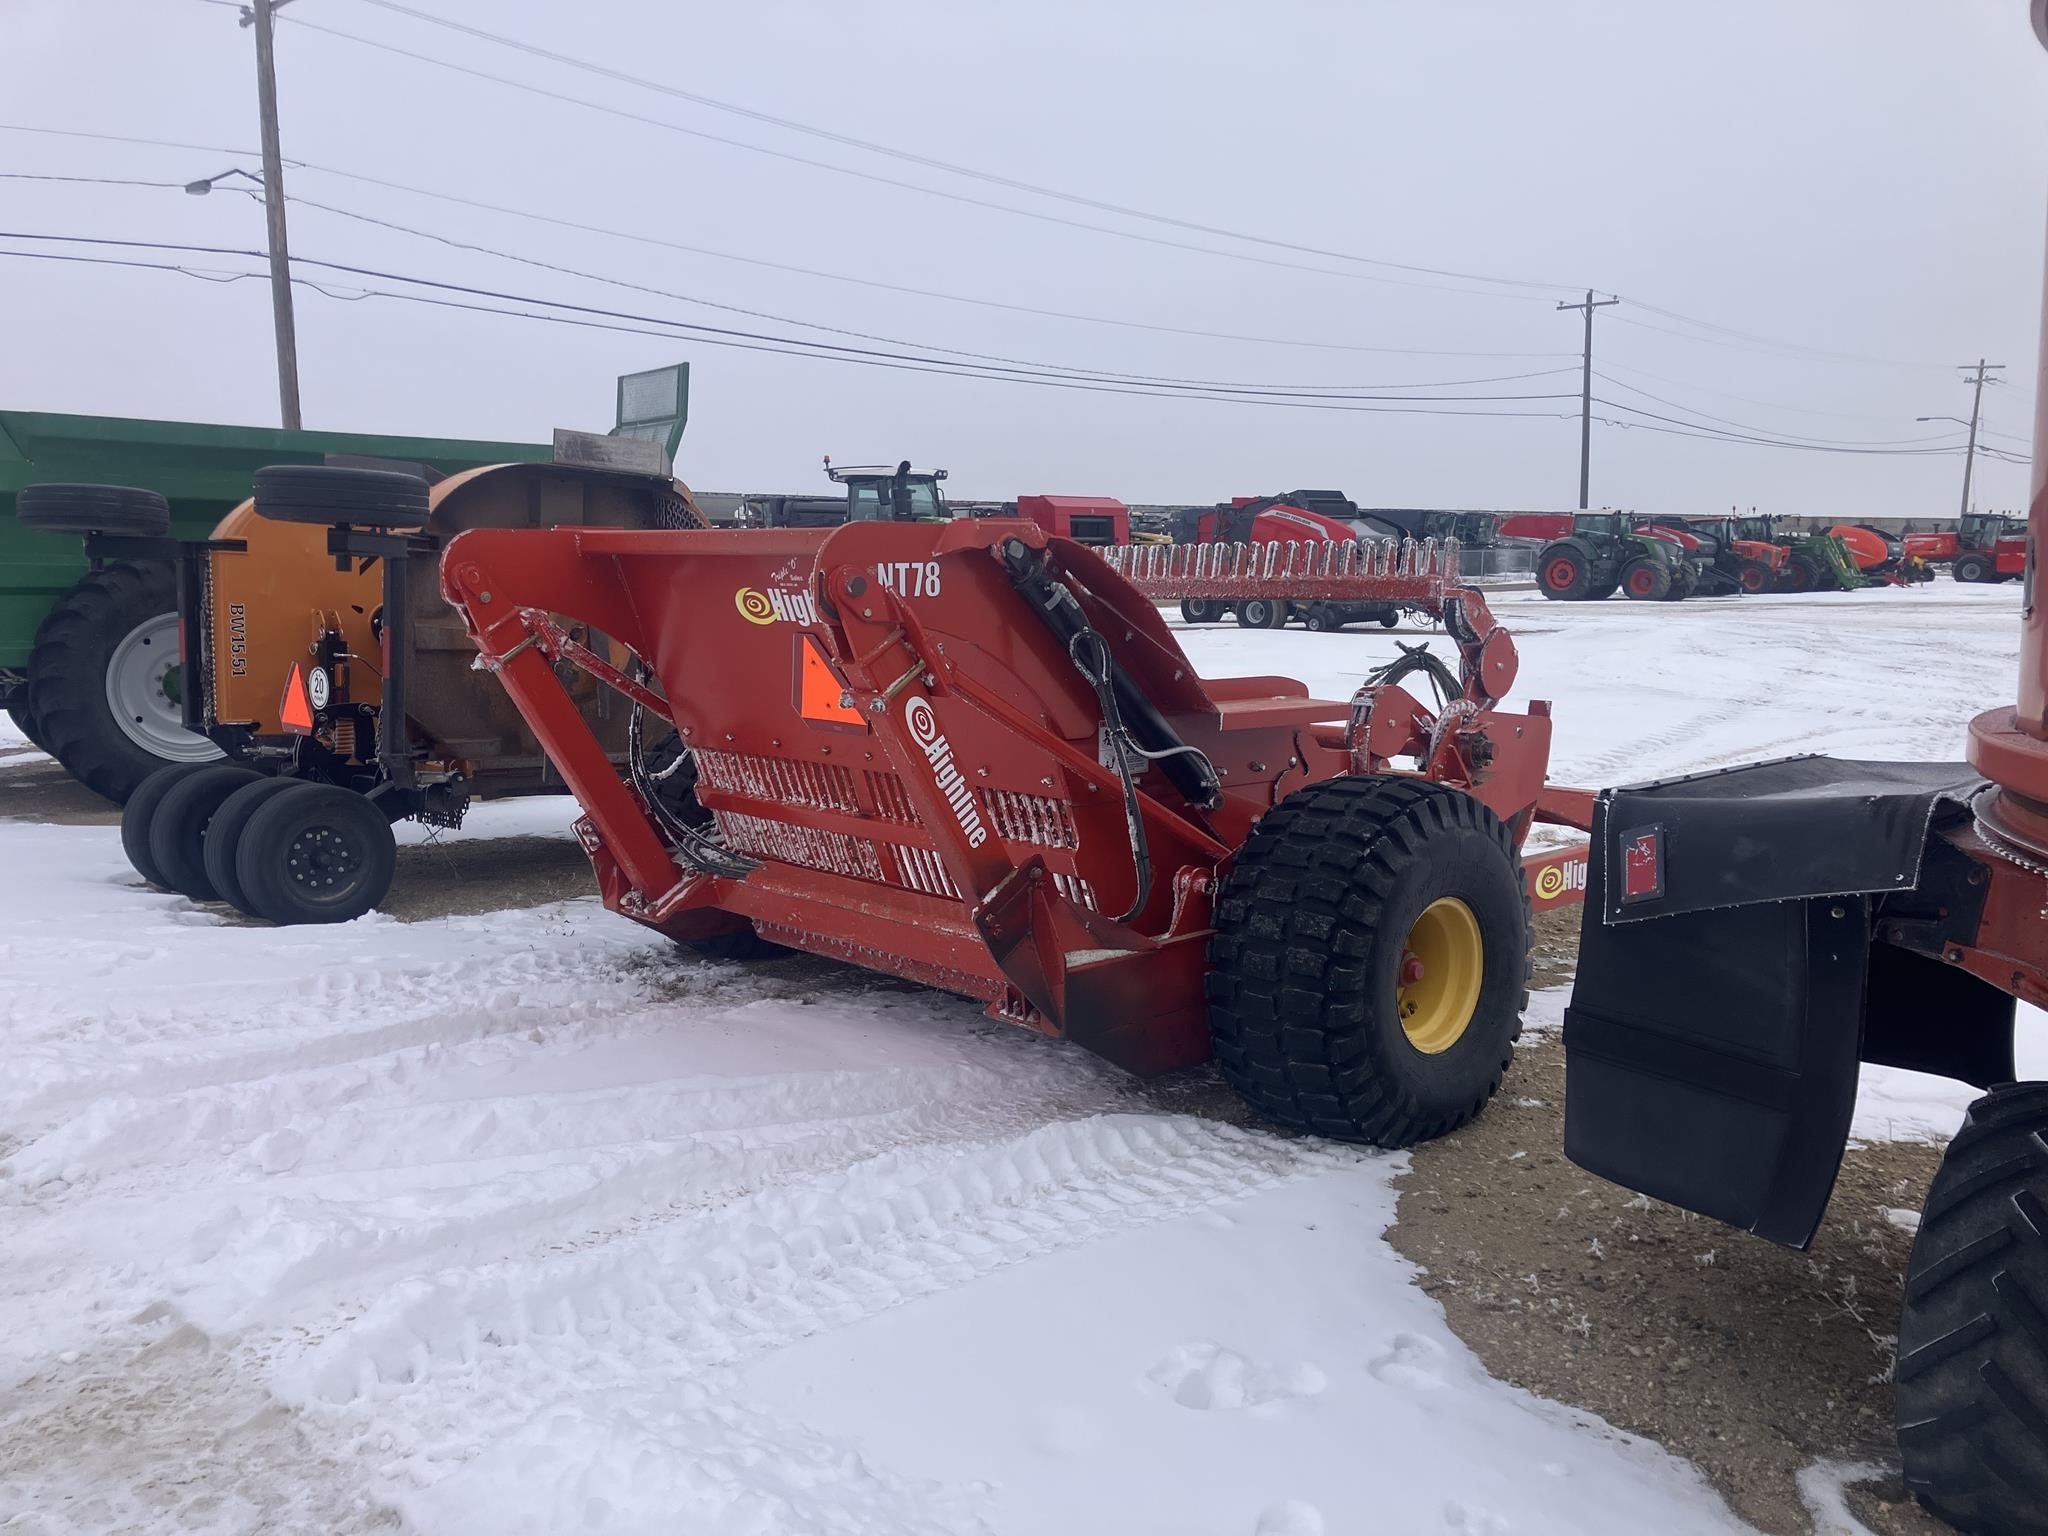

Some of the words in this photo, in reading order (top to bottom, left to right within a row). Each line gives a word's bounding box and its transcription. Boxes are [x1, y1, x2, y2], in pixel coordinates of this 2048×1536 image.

[878, 561, 941, 597] NT78
[230, 603, 246, 677] BW15.51
[314, 677, 324, 695] 20
[924, 734, 987, 849] Highline
[1562, 859, 1588, 891] Hig
